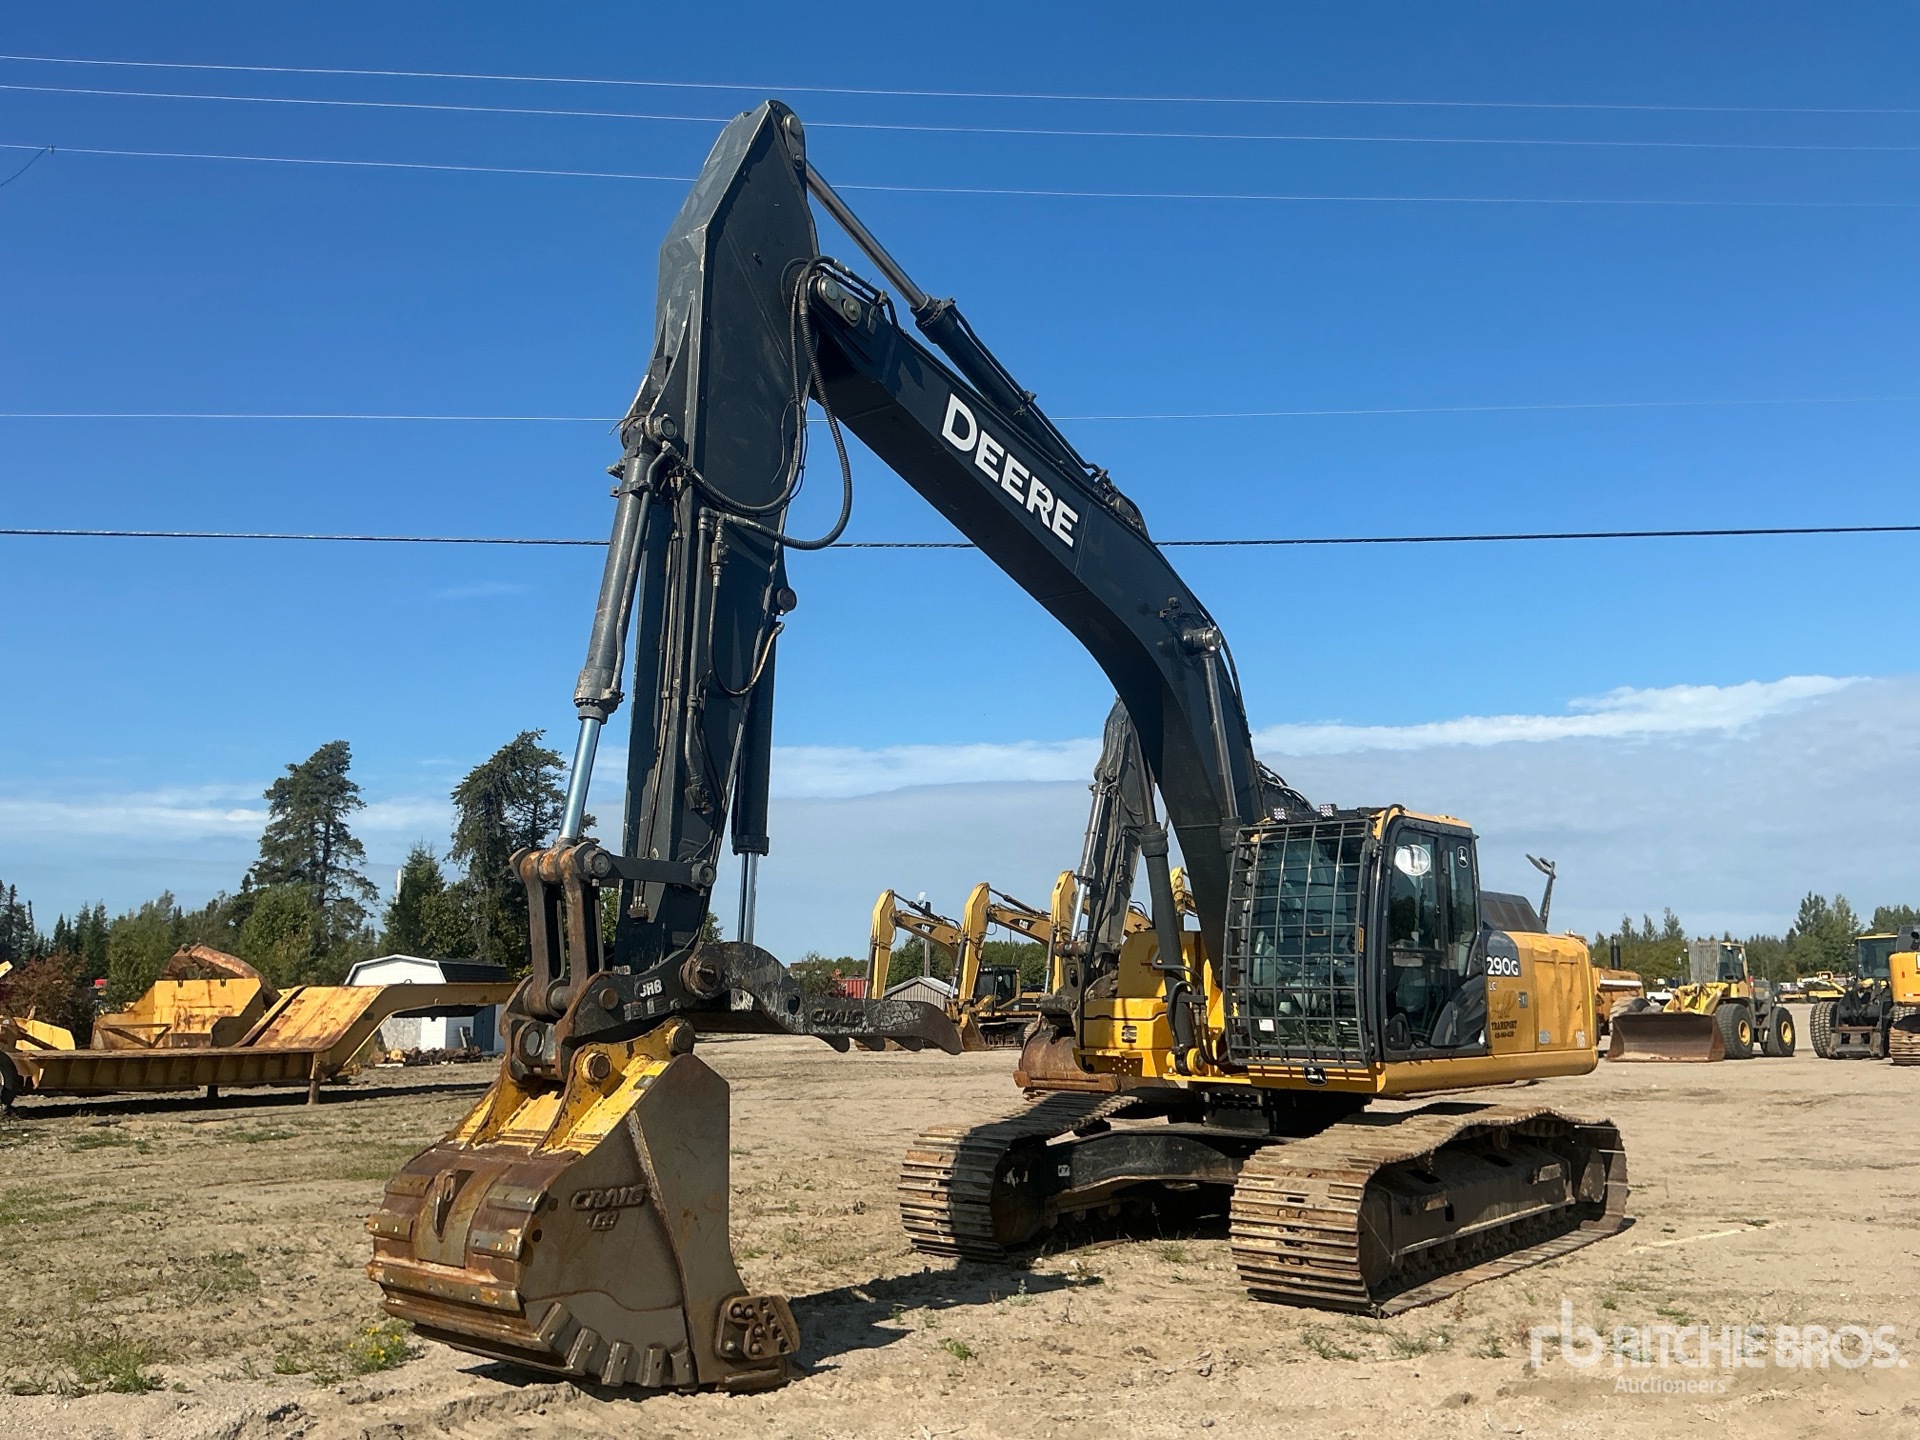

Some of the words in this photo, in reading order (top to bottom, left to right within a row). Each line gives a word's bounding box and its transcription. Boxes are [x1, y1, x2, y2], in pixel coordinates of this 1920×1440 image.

[942, 393, 1079, 548] DEERE
[1486, 956, 1519, 976] 290G
[1488, 981, 1497, 991] LC
[570, 1184, 645, 1210] CRAIG
